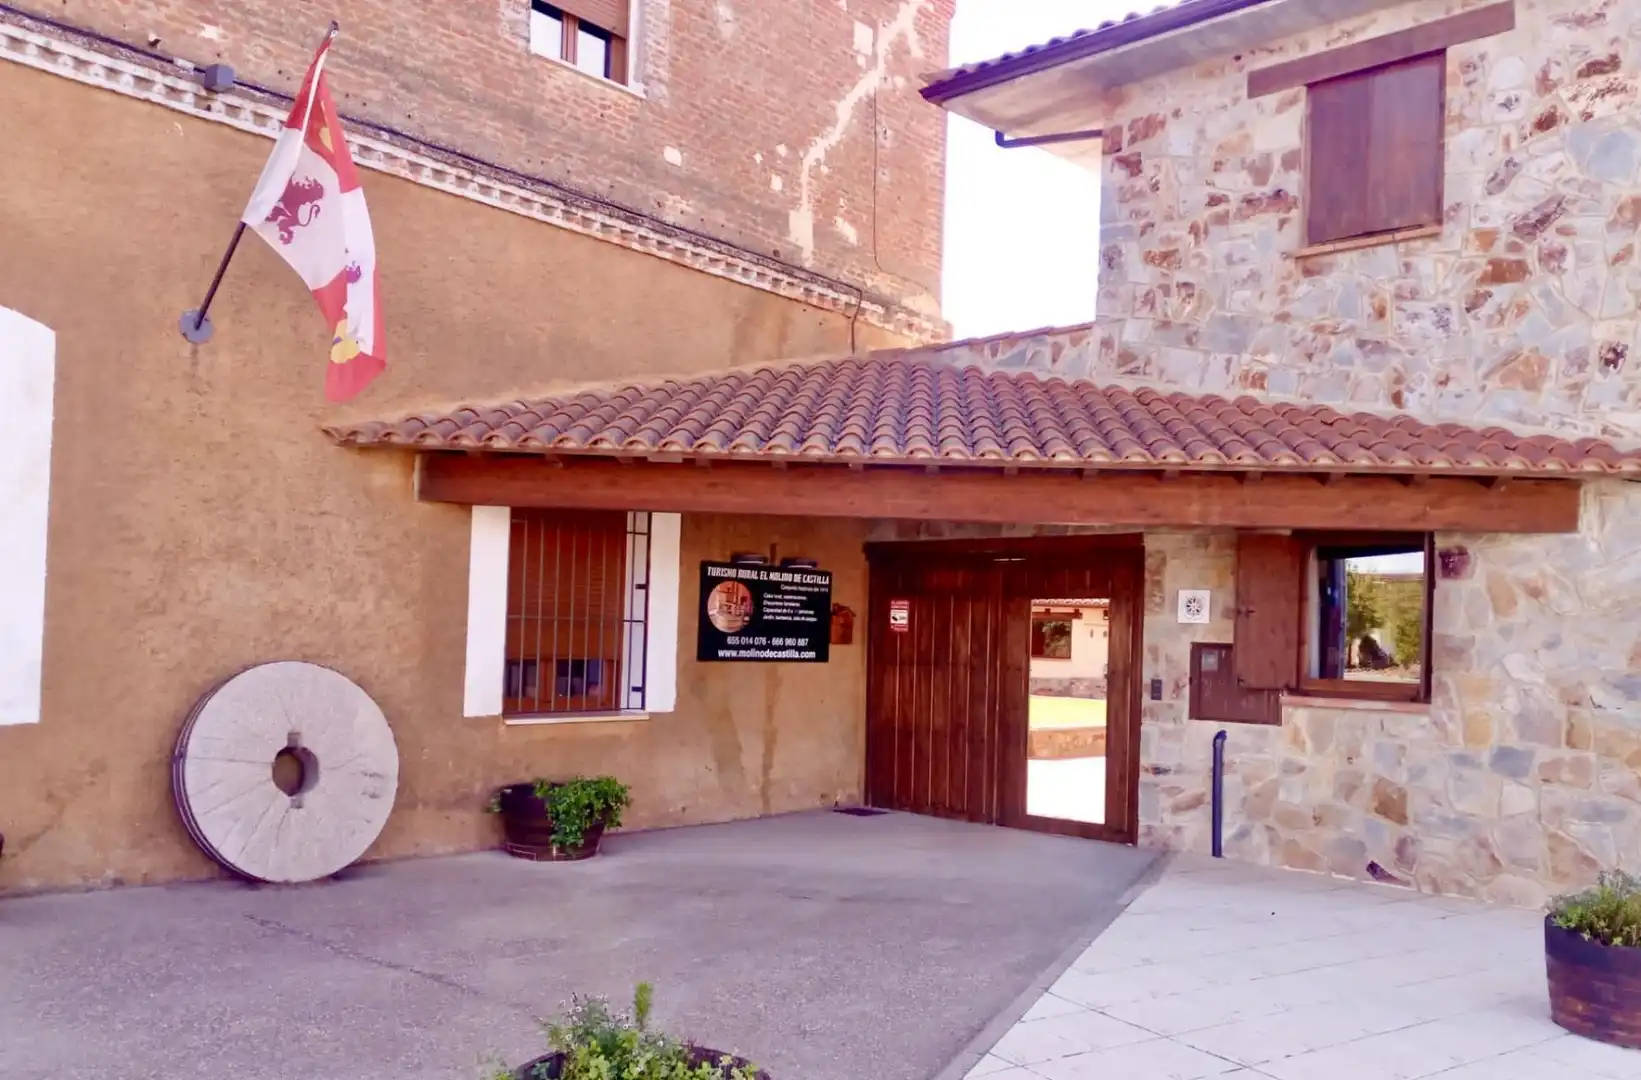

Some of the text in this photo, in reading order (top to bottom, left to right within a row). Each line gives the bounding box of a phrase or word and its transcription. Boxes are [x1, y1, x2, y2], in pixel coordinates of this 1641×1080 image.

[707, 566, 737, 578] TURISMO
[760, 570, 768, 580] EL
[769, 571, 793, 582] MOLINO
[793, 573, 802, 583] DE
[802, 574, 829, 585] CASTILLA
[727, 636, 740, 645] 655
[740, 636, 753, 645] 014
[754, 637, 767, 646] 076
[771, 637, 784, 646] 666
[717, 648, 816, 659] www.molinodecastilla.com
